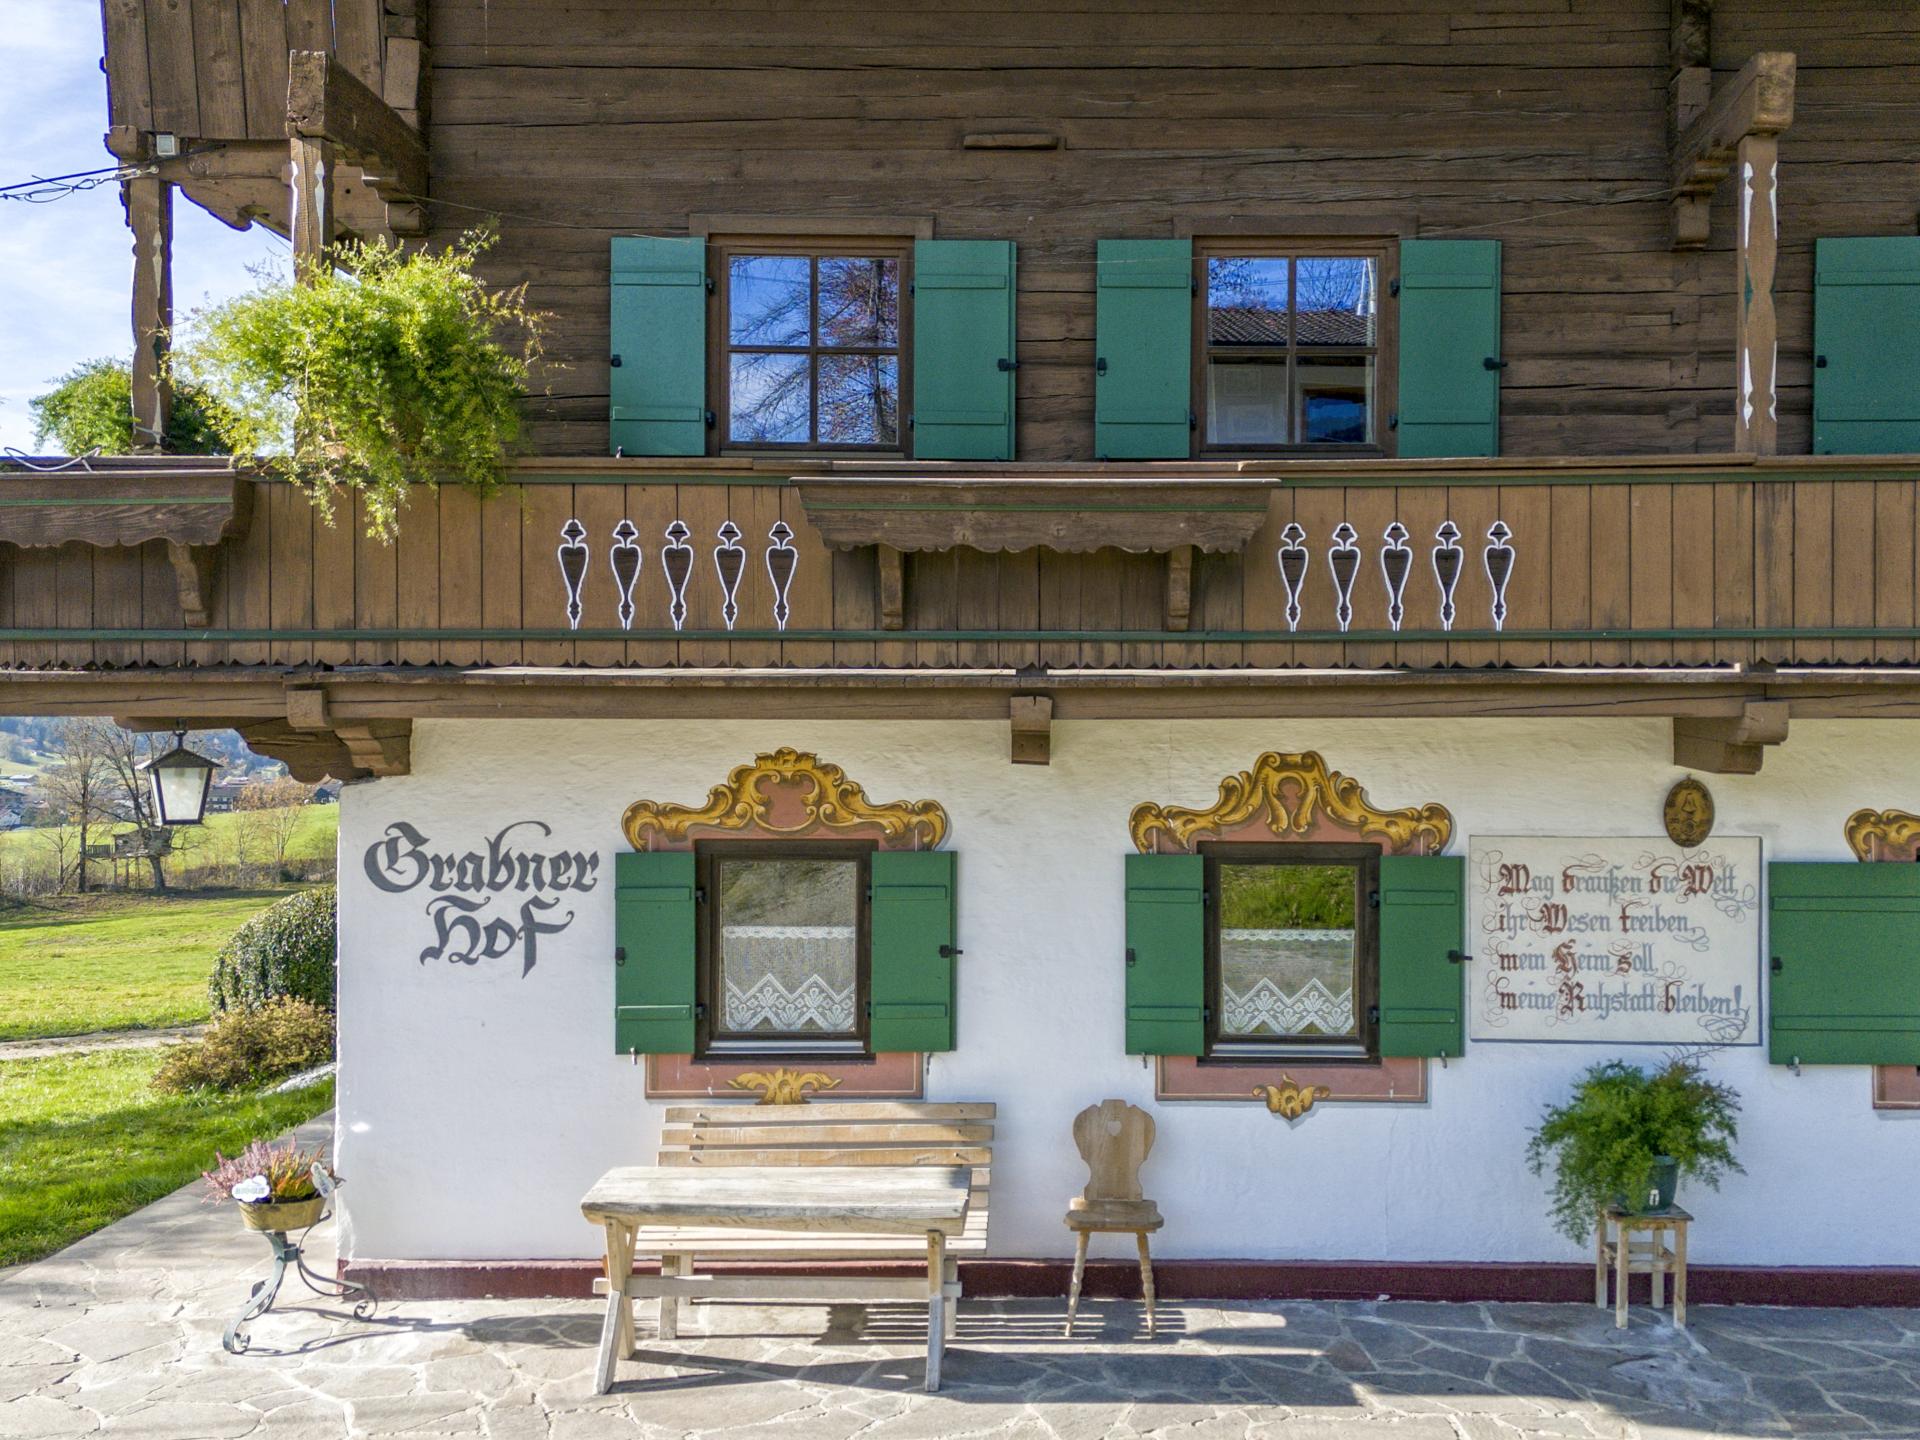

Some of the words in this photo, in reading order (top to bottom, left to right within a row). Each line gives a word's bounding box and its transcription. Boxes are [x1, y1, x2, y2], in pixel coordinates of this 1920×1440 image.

[364, 821, 600, 893] Grabner
[1498, 863, 1554, 900] Mag
[1649, 863, 1679, 894] die
[419, 894, 575, 979] Hof
[1498, 902, 1528, 940] ihr
[1539, 902, 1612, 934] Wesen
[1499, 942, 1546, 972] mein
[1552, 938, 1612, 977] Heim
[1498, 980, 1557, 1011] meine
[1557, 975, 1656, 1020] Ruhstatt
[1664, 980, 1743, 1016] bleiben!
